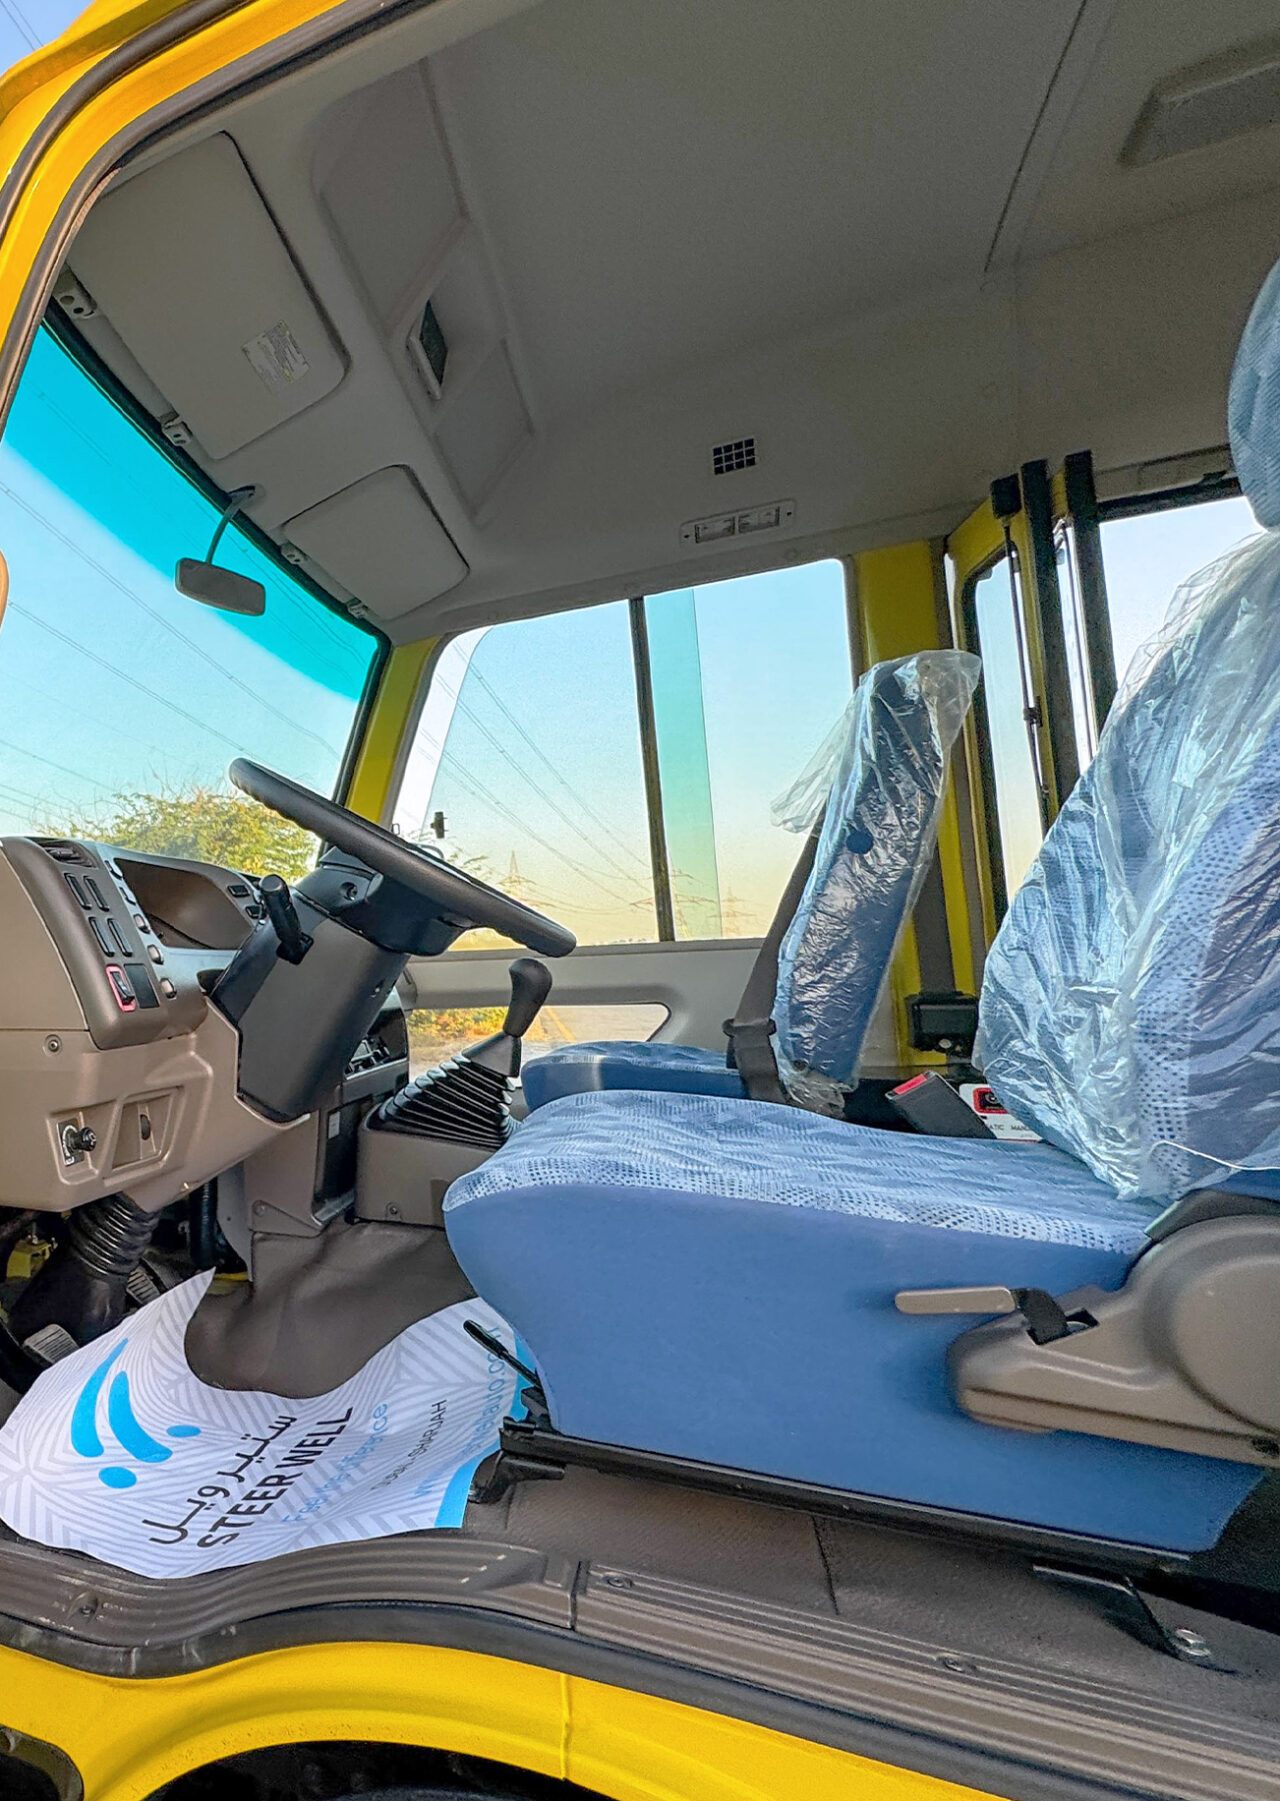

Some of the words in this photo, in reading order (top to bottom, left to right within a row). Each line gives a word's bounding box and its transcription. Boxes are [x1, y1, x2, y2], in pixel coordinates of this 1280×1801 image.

[197, 1472, 303, 1548] STEER
[275, 1406, 353, 1469] WELL
[217, 1415, 297, 1483] ستير
